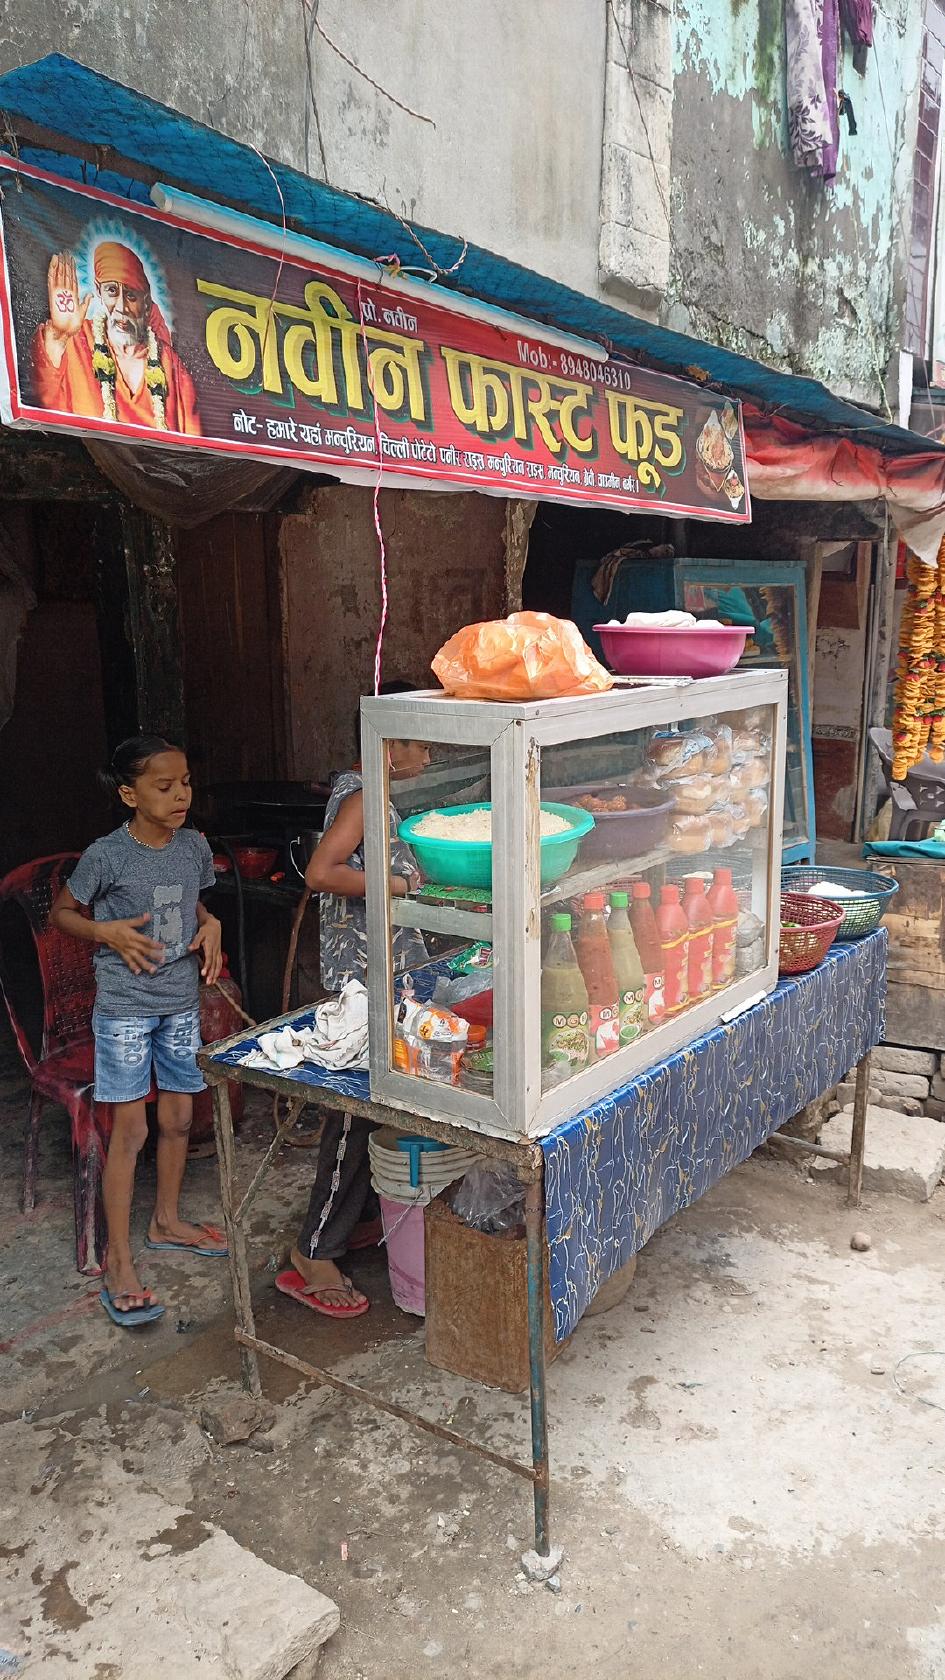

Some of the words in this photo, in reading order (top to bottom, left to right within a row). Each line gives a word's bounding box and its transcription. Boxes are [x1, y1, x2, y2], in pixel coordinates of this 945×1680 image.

[382, 306, 418, 333] नवीन
[197, 280, 425, 423] नवीन
[441, 346, 597, 454] फास्ट
[604, 389, 685, 488] फूड
[560, 353, 631, 390] 8948046310
[265, 416, 298, 442] हमारे
[380, 432, 410, 459] चिल्ली
[439, 444, 463, 467] पनीर
[173, 1011, 193, 1060] HERO
